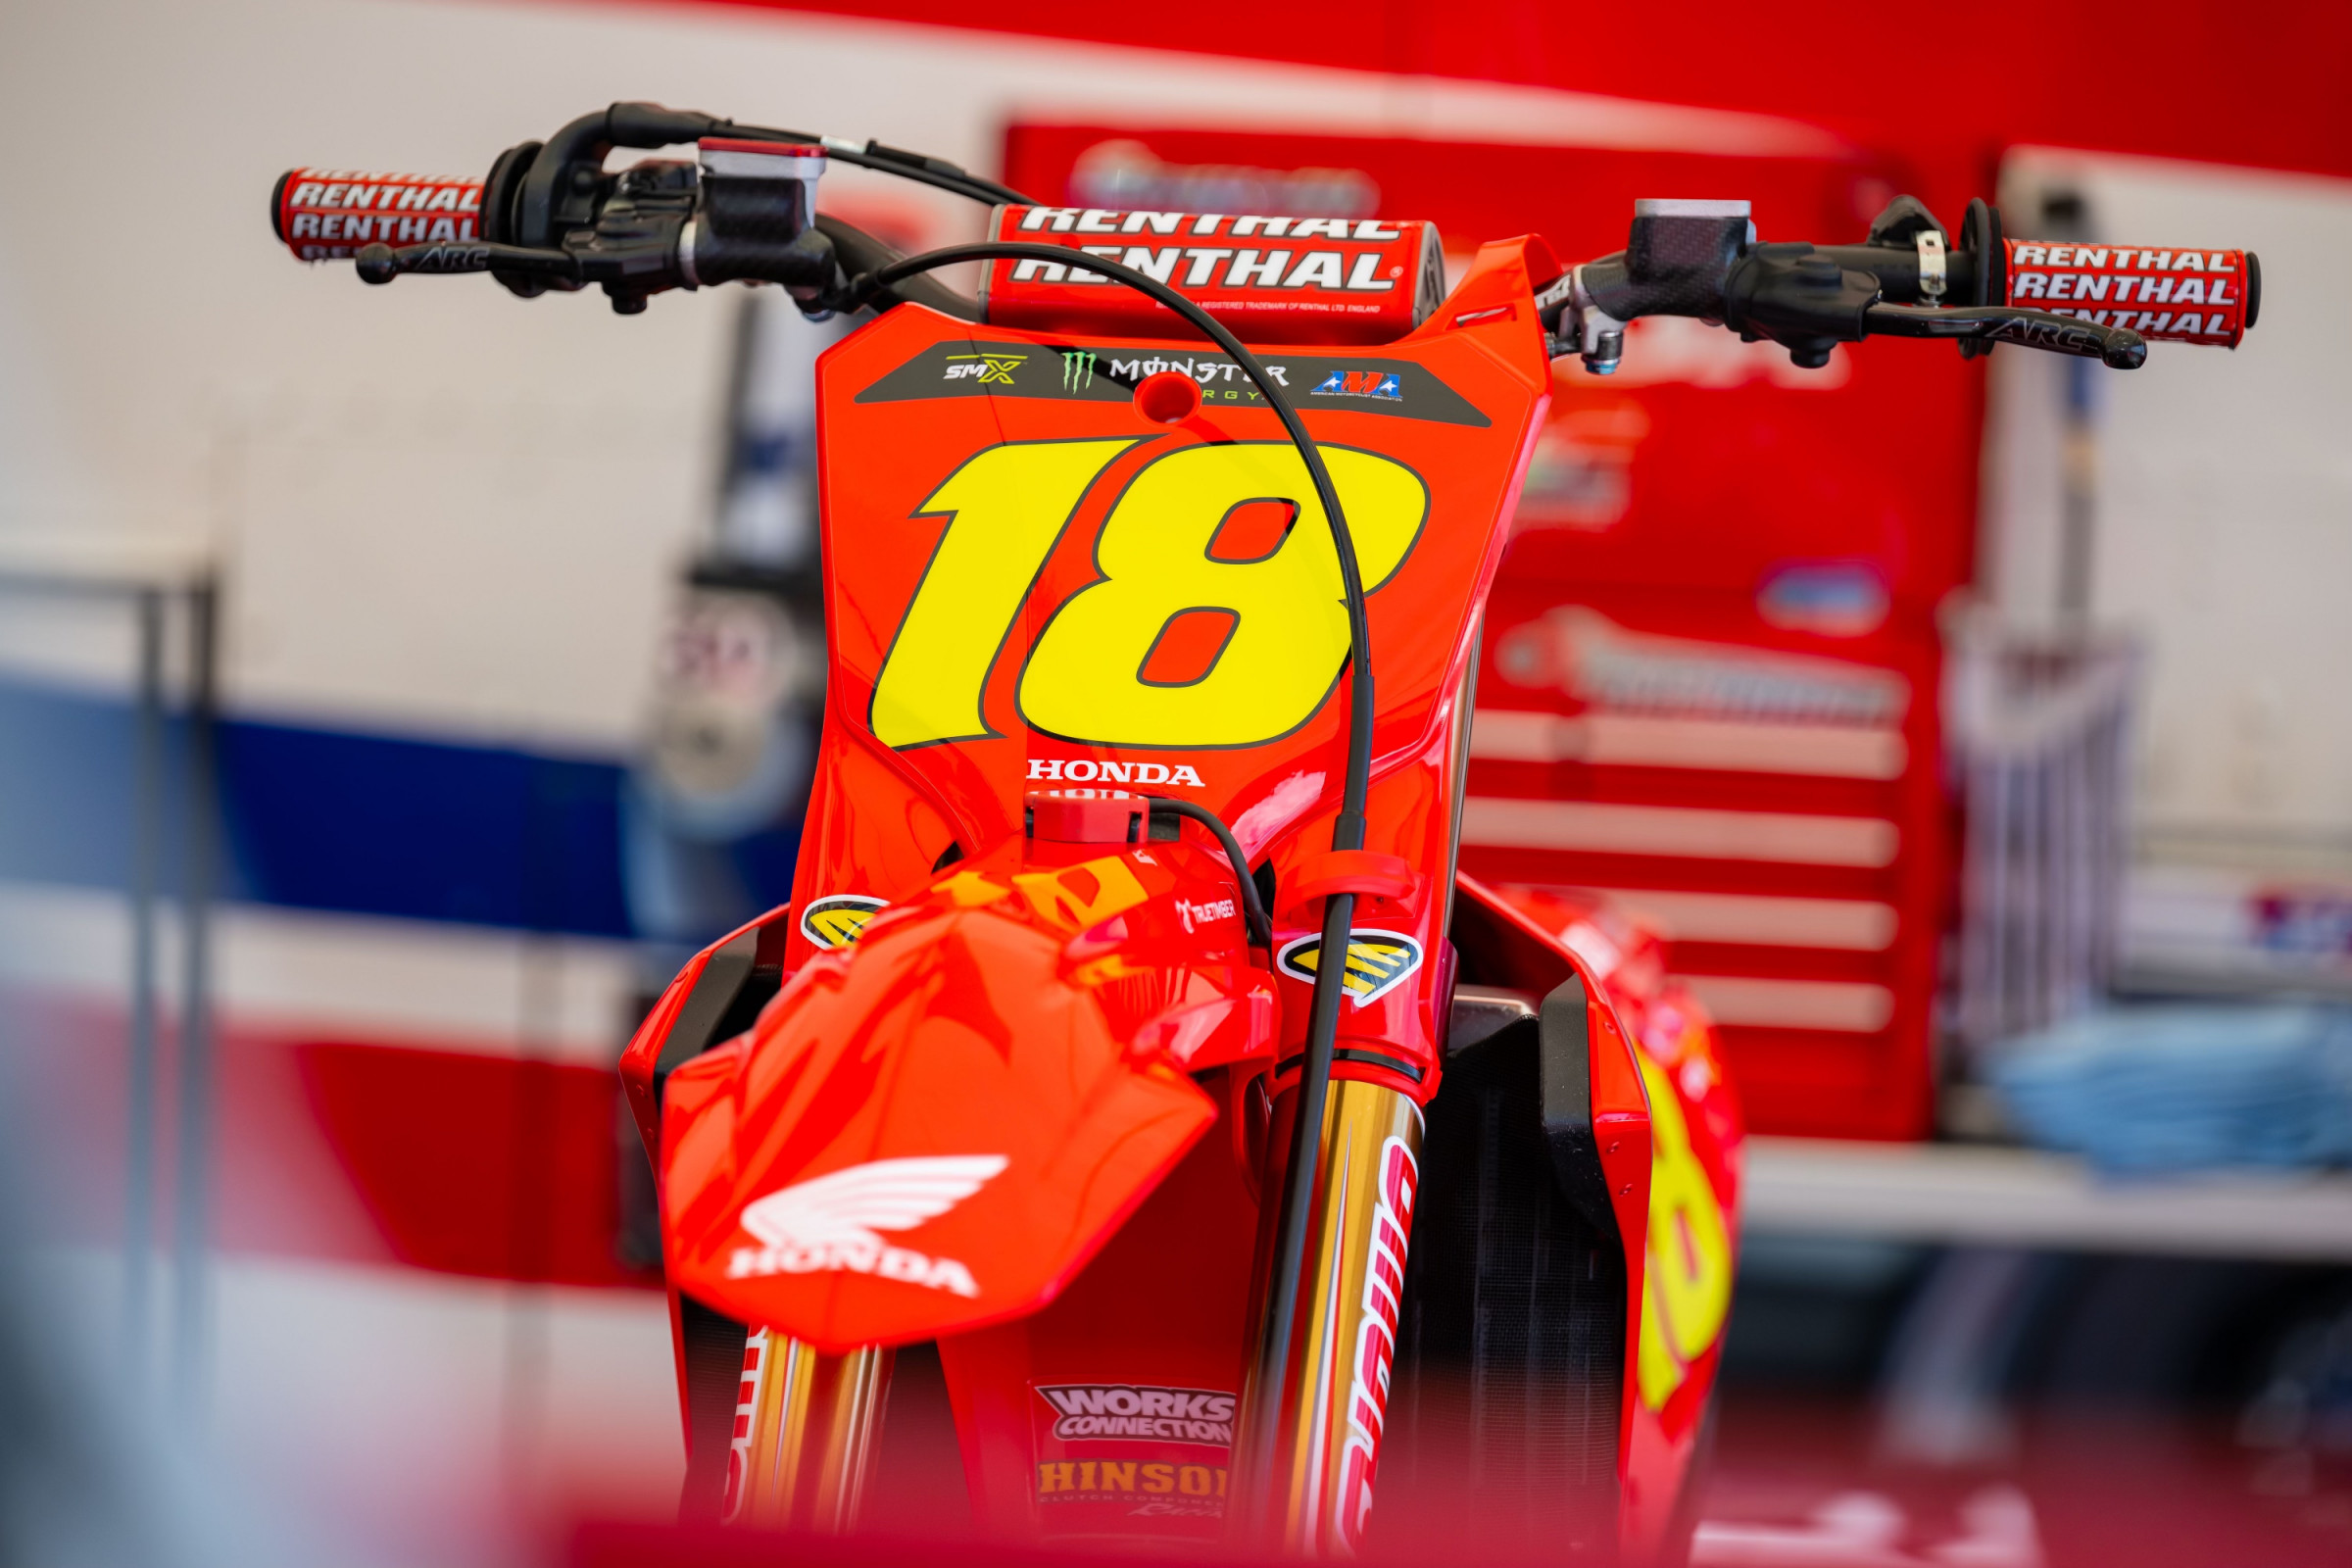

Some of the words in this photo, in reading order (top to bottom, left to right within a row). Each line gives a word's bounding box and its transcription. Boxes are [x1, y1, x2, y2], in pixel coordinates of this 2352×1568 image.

[289, 181, 480, 212] RENTHAL
[291, 213, 480, 242] RENTHAL
[415, 246, 491, 270] ARC
[2013, 245, 2235, 272] RENTHAL
[2013, 271, 2235, 306] RENTHAL
[2025, 307, 2232, 335] NTHAL
[1109, 356, 1290, 387] MONSTR
[1310, 370, 1403, 398] AMA
[866, 432, 1431, 752] 18
[1025, 759, 1206, 788] HONDA
[725, 1238, 980, 1299] HONDA
[1048, 1388, 1236, 1422] WORKS
[1058, 1416, 1232, 1444] CONNECTION
